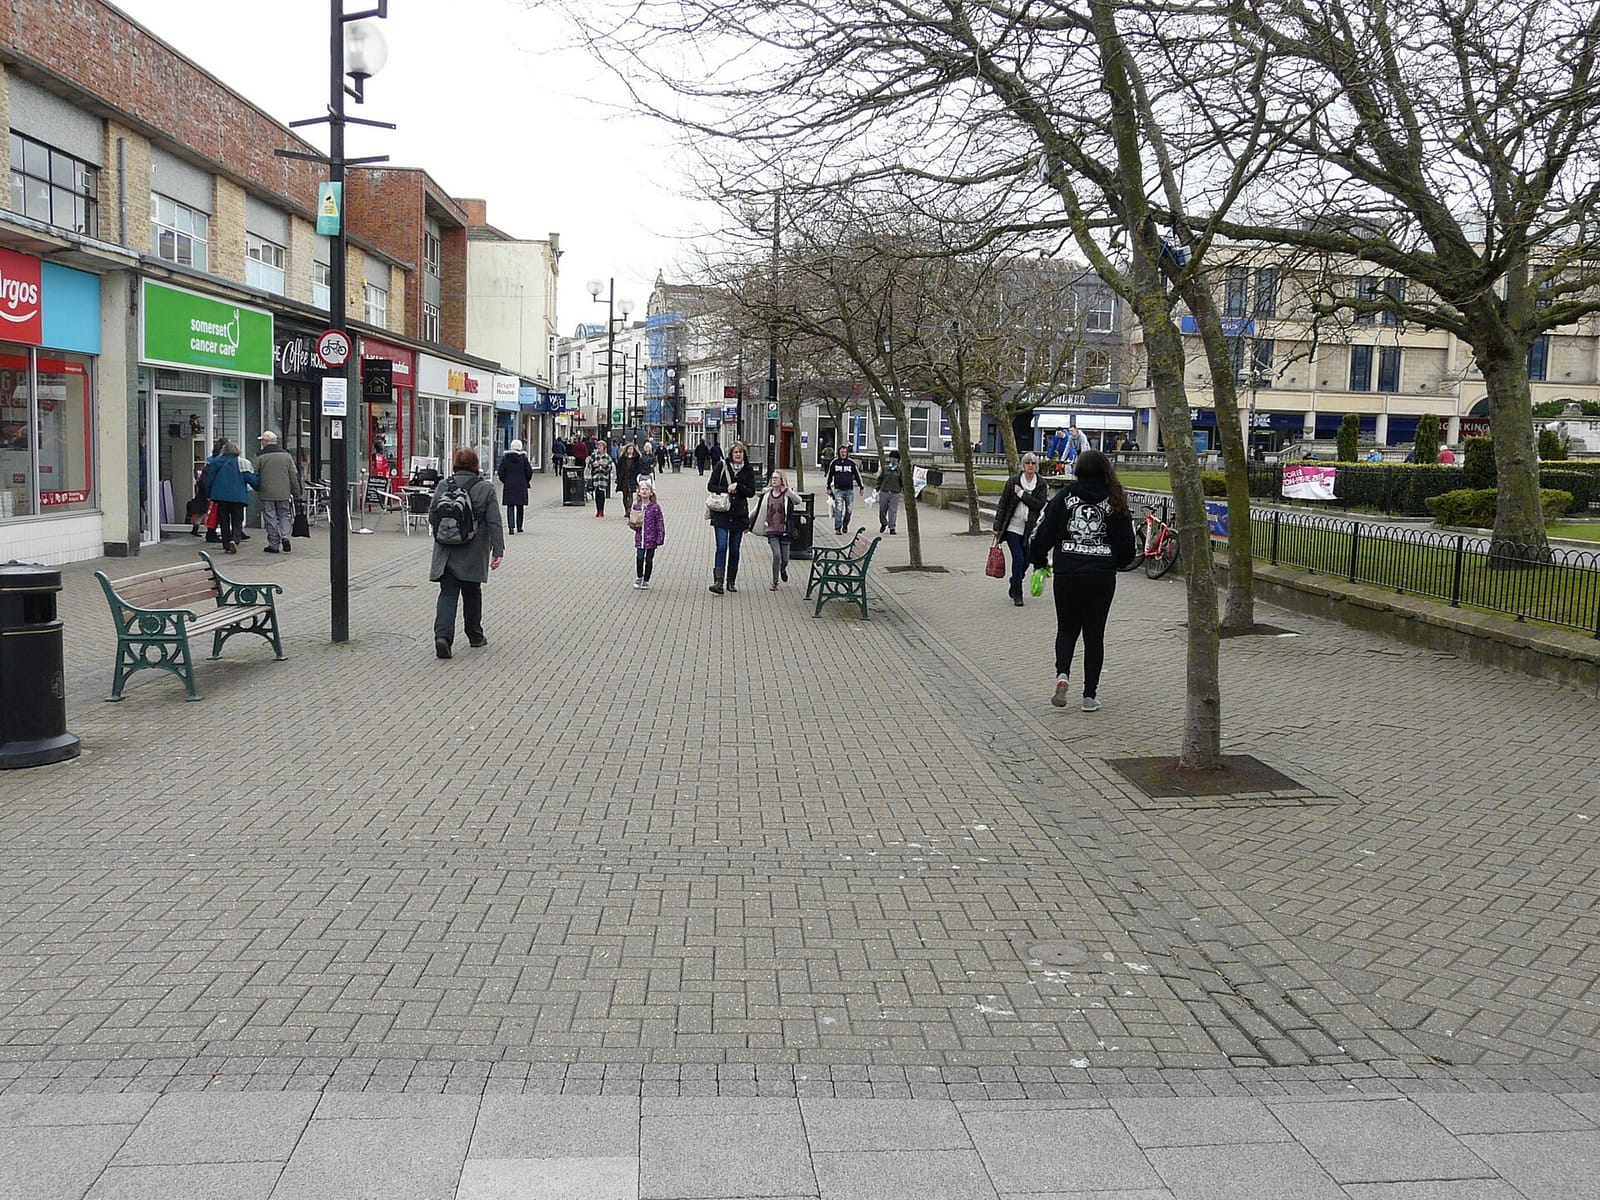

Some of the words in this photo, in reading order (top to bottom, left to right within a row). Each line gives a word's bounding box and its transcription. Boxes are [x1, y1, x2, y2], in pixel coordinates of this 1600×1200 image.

[0, 269, 38, 310] rgos
[190, 318, 227, 338] somerset
[190, 337, 217, 354] cancer
[219, 343, 236, 357] care
[281, 337, 309, 375] Coffee
[1463, 423, 1490, 433] KING
